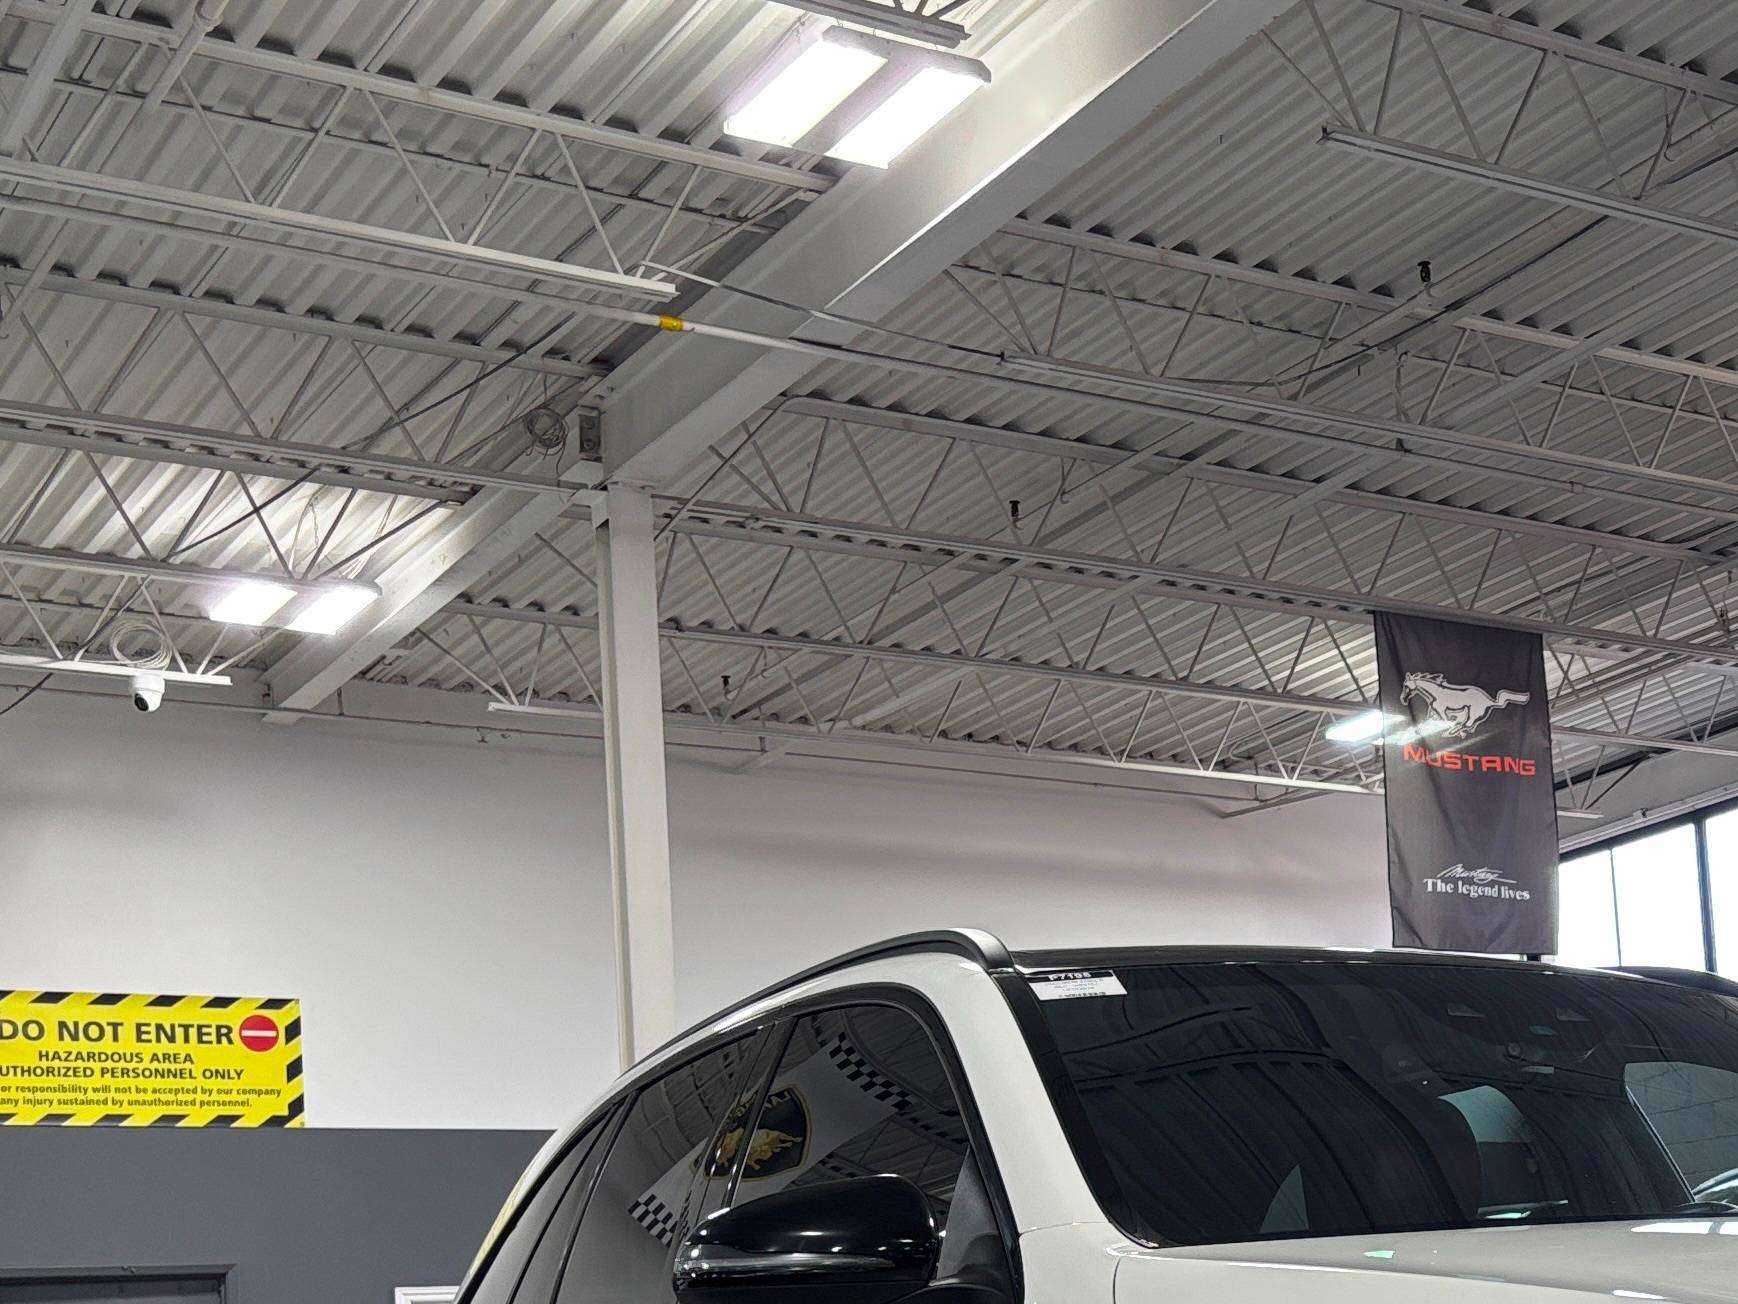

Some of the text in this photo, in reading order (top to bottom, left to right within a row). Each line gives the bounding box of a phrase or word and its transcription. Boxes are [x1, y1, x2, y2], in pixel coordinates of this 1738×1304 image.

[1403, 743, 1536, 776] MUSTANG
[1424, 878, 1531, 900] The legend lives
[0, 1019, 235, 1046] DO NOT ENTER
[38, 1049, 195, 1065] HAZARDOUS AREA
[0, 1064, 245, 1081] UTHORIZED PERSONNEL ONLY
[16, 1084, 88, 1096] responsibility
[92, 1084, 112, 1094] will
[114, 1085, 132, 1095] not
[135, 1085, 149, 1095] be
[151, 1085, 198, 1097] accepted
[200, 1086, 214, 1097] by
[216, 1087, 233, 1096] our
[236, 1087, 282, 1098] company
[22, 1096, 54, 1108] injury
[57, 1096, 109, 1106] sustained
[112, 1097, 125, 1108] by
[127, 1097, 197, 1108] unauthorized
